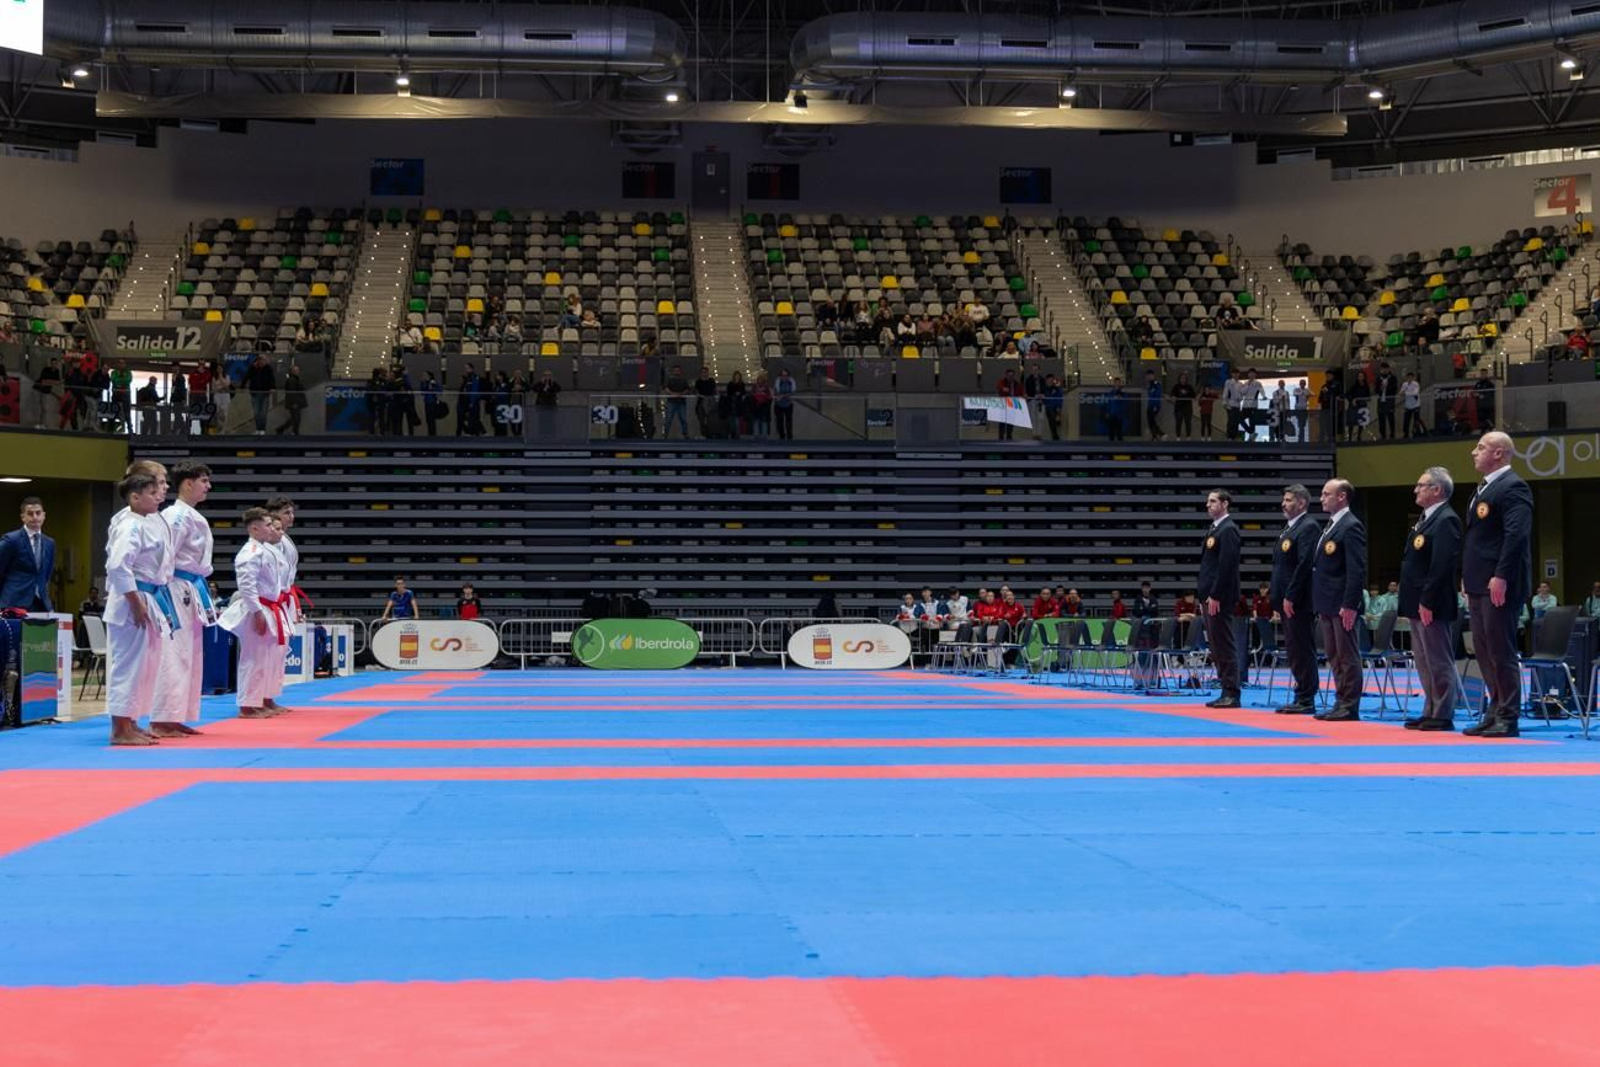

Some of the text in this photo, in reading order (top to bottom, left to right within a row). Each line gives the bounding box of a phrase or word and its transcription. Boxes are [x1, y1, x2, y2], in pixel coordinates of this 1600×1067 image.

[1533, 178, 1571, 188] Sector
[1548, 177, 1580, 215] 4
[116, 327, 201, 349] Salida 12
[223, 353, 249, 361] Sector
[1245, 337, 1323, 359] Salida 1
[325, 387, 366, 399] Sector
[1434, 388, 1472, 400] Sector
[497, 405, 523, 424] 30
[592, 405, 619, 424] 30
[1357, 408, 1371, 427] 3
[635, 636, 694, 650] Iberdrola
